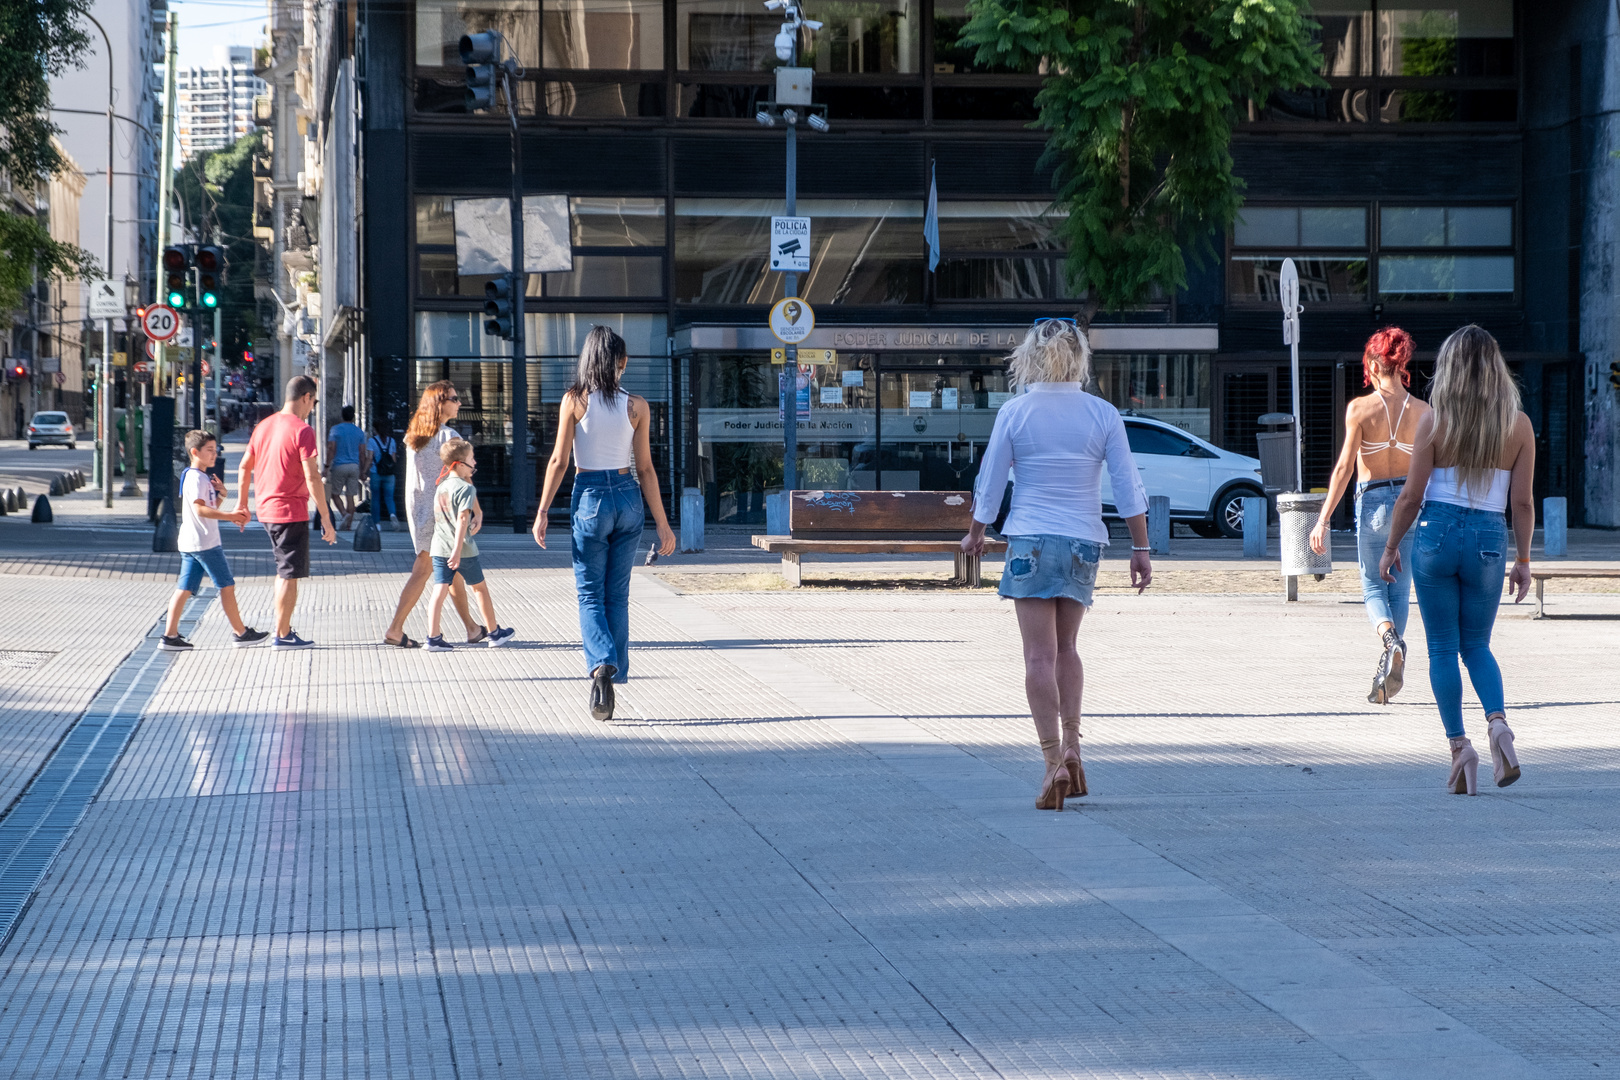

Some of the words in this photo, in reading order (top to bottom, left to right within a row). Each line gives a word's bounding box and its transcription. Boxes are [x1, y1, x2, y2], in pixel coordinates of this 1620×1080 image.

[775, 221, 807, 230] POLICIA
[151, 315, 171, 330] 20
[833, 332, 887, 346] PODER
[894, 332, 959, 346] JUDICIAL
[968, 332, 989, 346] DE
[997, 332, 1017, 345] LA
[724, 421, 751, 429] Poder
[754, 421, 784, 429] Judici
[808, 421, 816, 429] la
[820, 421, 853, 429] Nación
